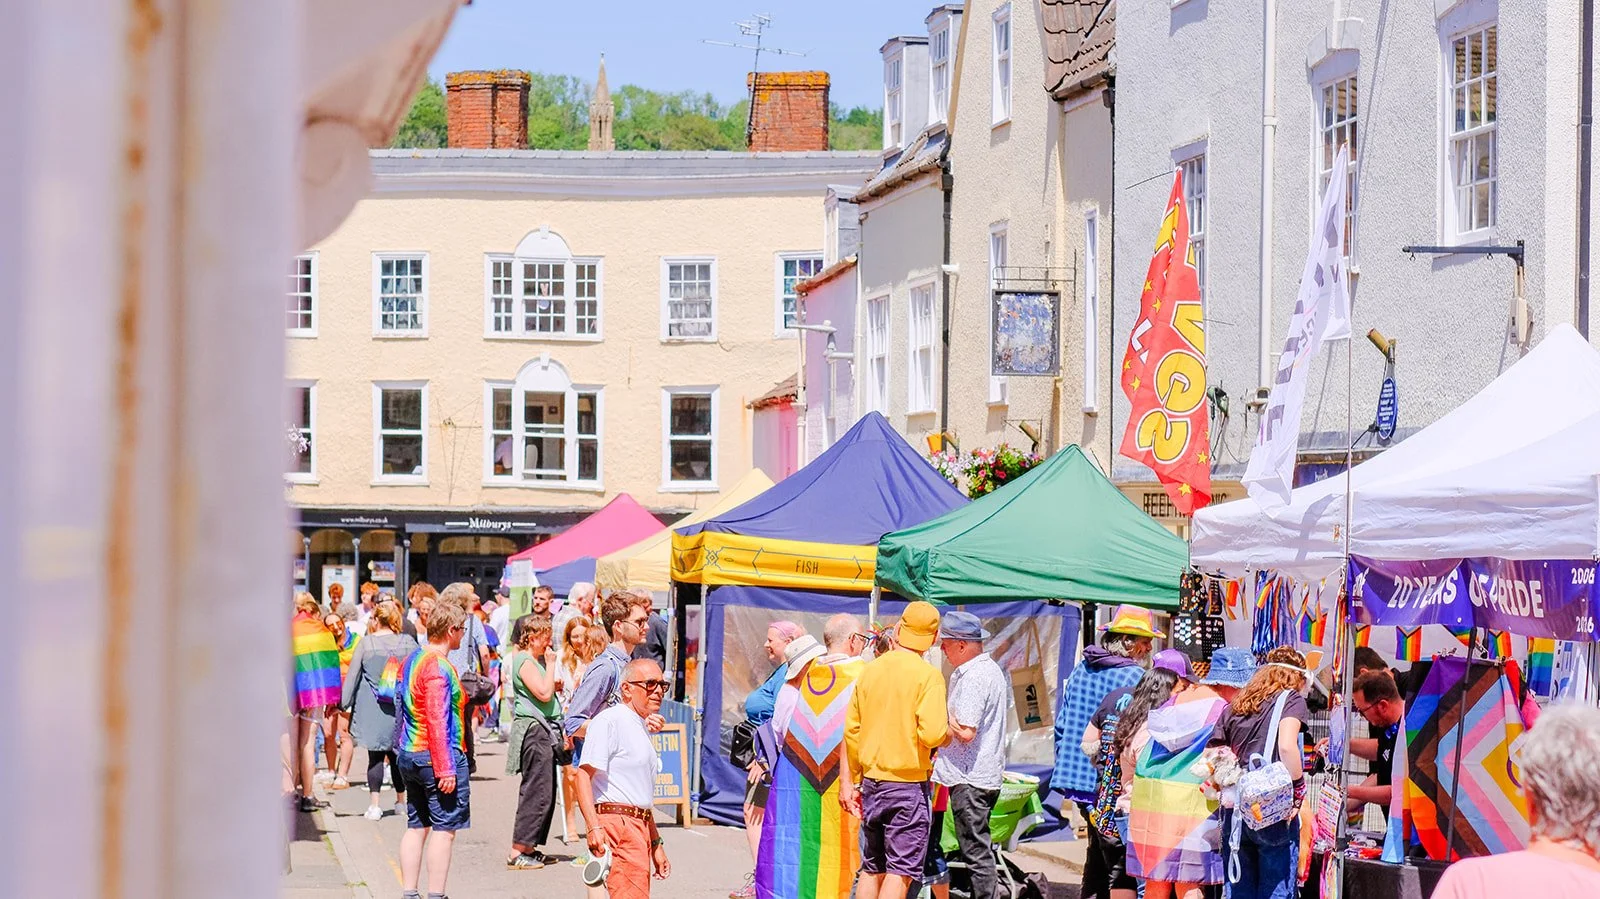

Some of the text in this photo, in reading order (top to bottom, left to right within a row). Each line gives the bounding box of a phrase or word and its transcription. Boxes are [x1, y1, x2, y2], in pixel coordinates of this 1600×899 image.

[469, 517, 512, 531] Milburys
[795, 559, 819, 575] FISH
[1571, 567, 1595, 585] 2006
[1387, 574, 1414, 609] 20
[1468, 570, 1489, 608] OF
[1489, 575, 1545, 618] PRIDE
[663, 734, 679, 752] FIN
